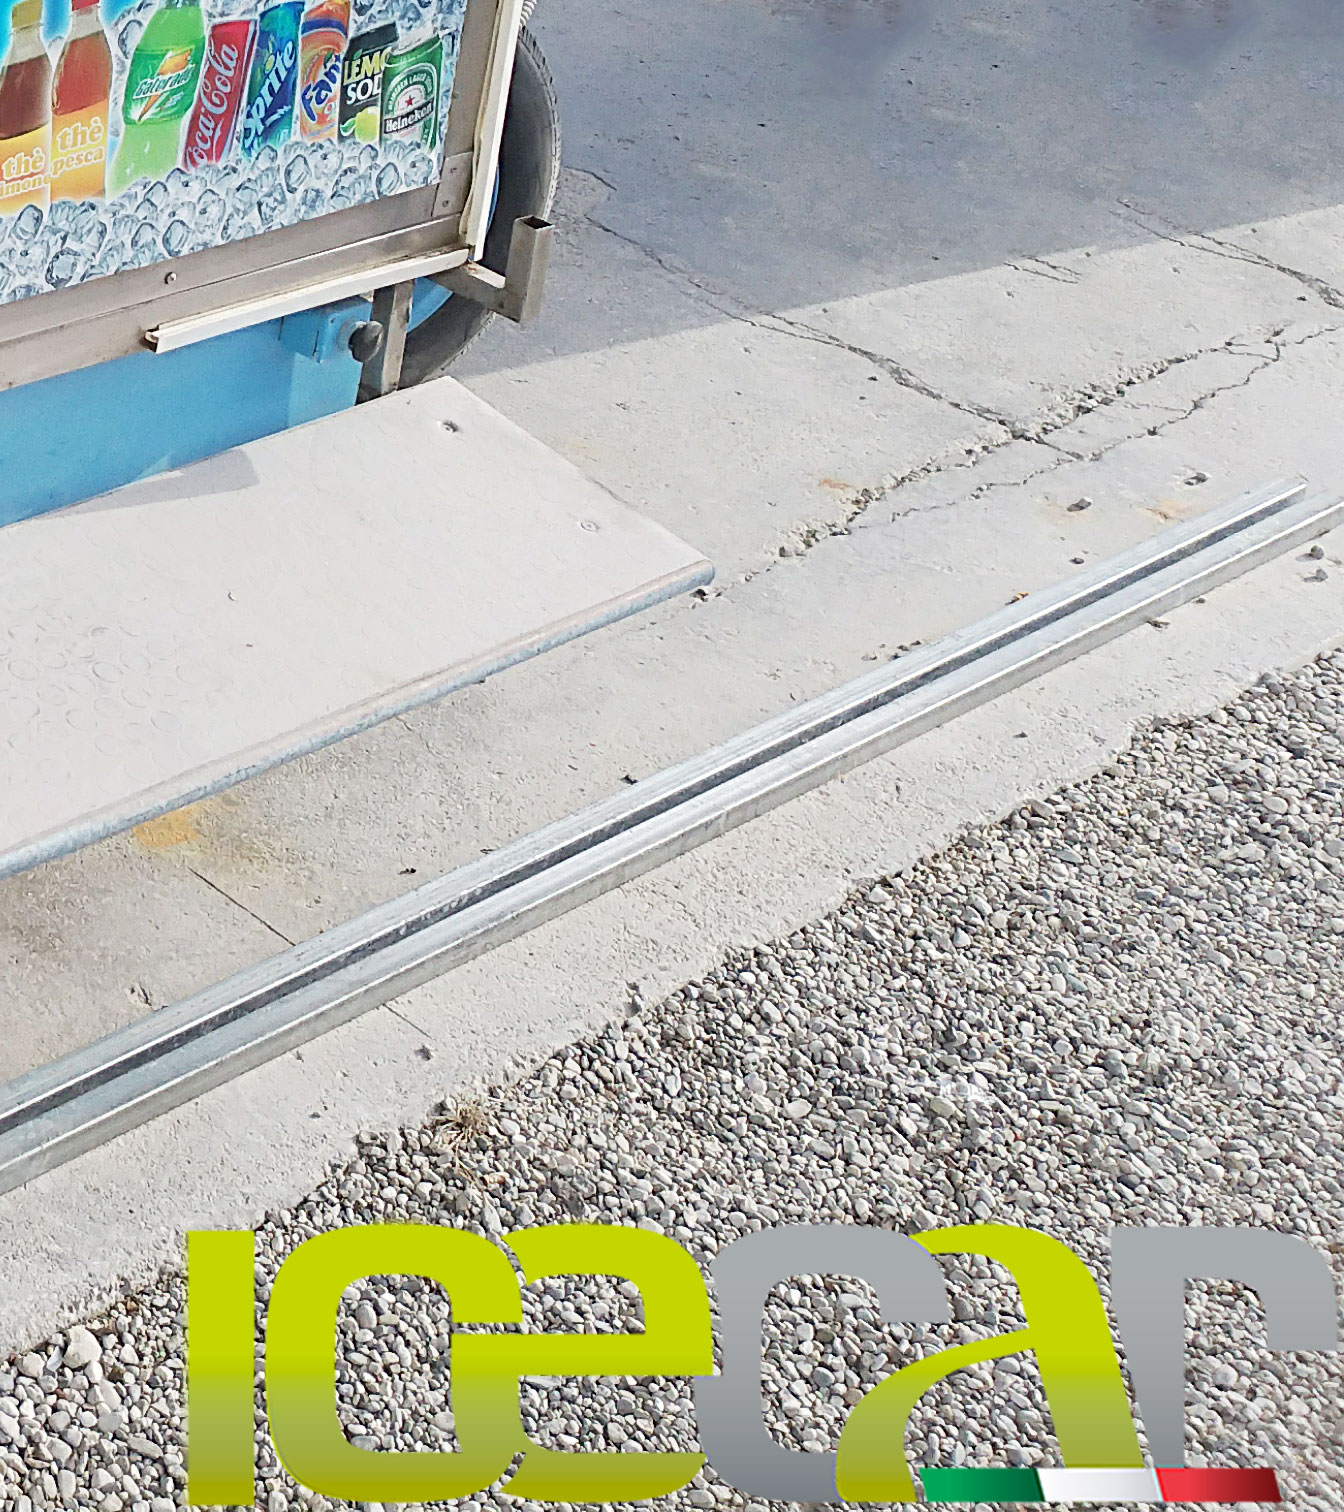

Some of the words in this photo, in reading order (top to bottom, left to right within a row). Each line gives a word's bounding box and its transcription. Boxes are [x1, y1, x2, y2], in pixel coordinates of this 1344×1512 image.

[243, 40, 296, 148] Sprite
[385, 102, 432, 132] Heineken
[58, 117, 103, 152] thè
[2, 147, 45, 180] thè
[51, 147, 105, 177] pesca
